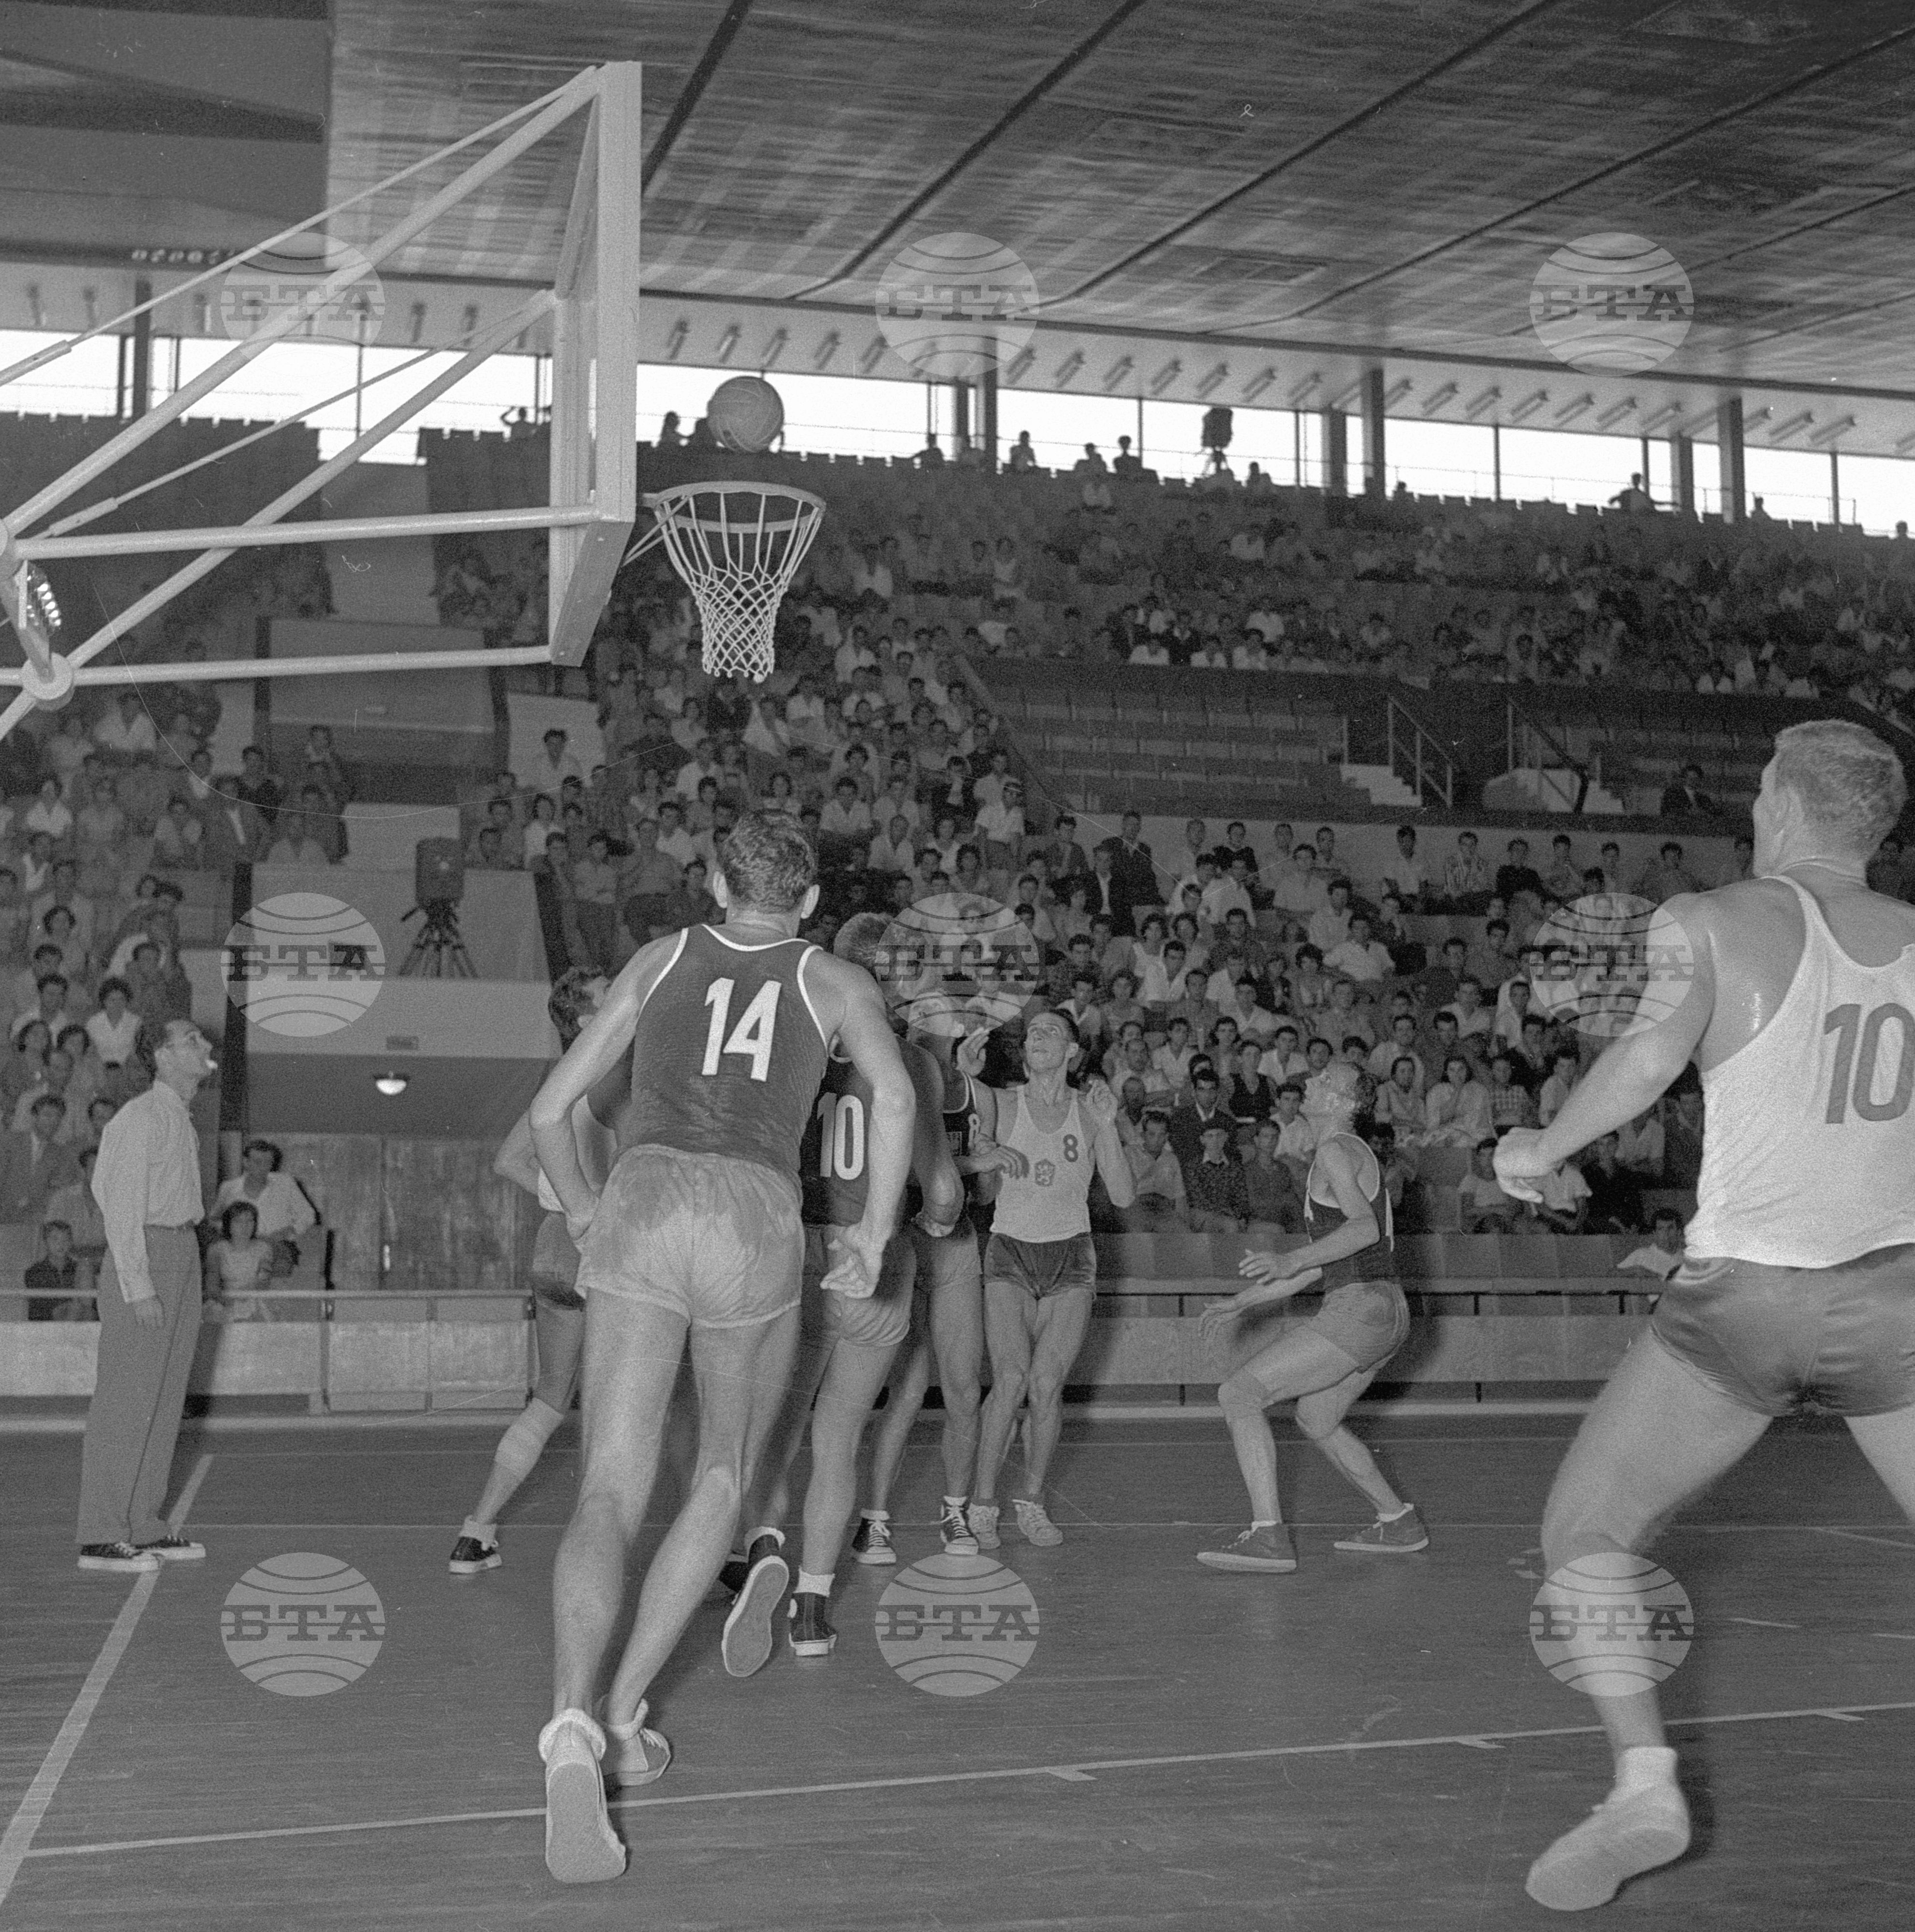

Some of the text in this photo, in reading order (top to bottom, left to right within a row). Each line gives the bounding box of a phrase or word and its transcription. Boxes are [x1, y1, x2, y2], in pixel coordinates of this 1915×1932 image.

[702, 977, 782, 1082] 14
[1823, 1002, 1915, 1123] 10
[817, 1092, 864, 1180] 10
[1063, 1134, 1078, 1163] 8
